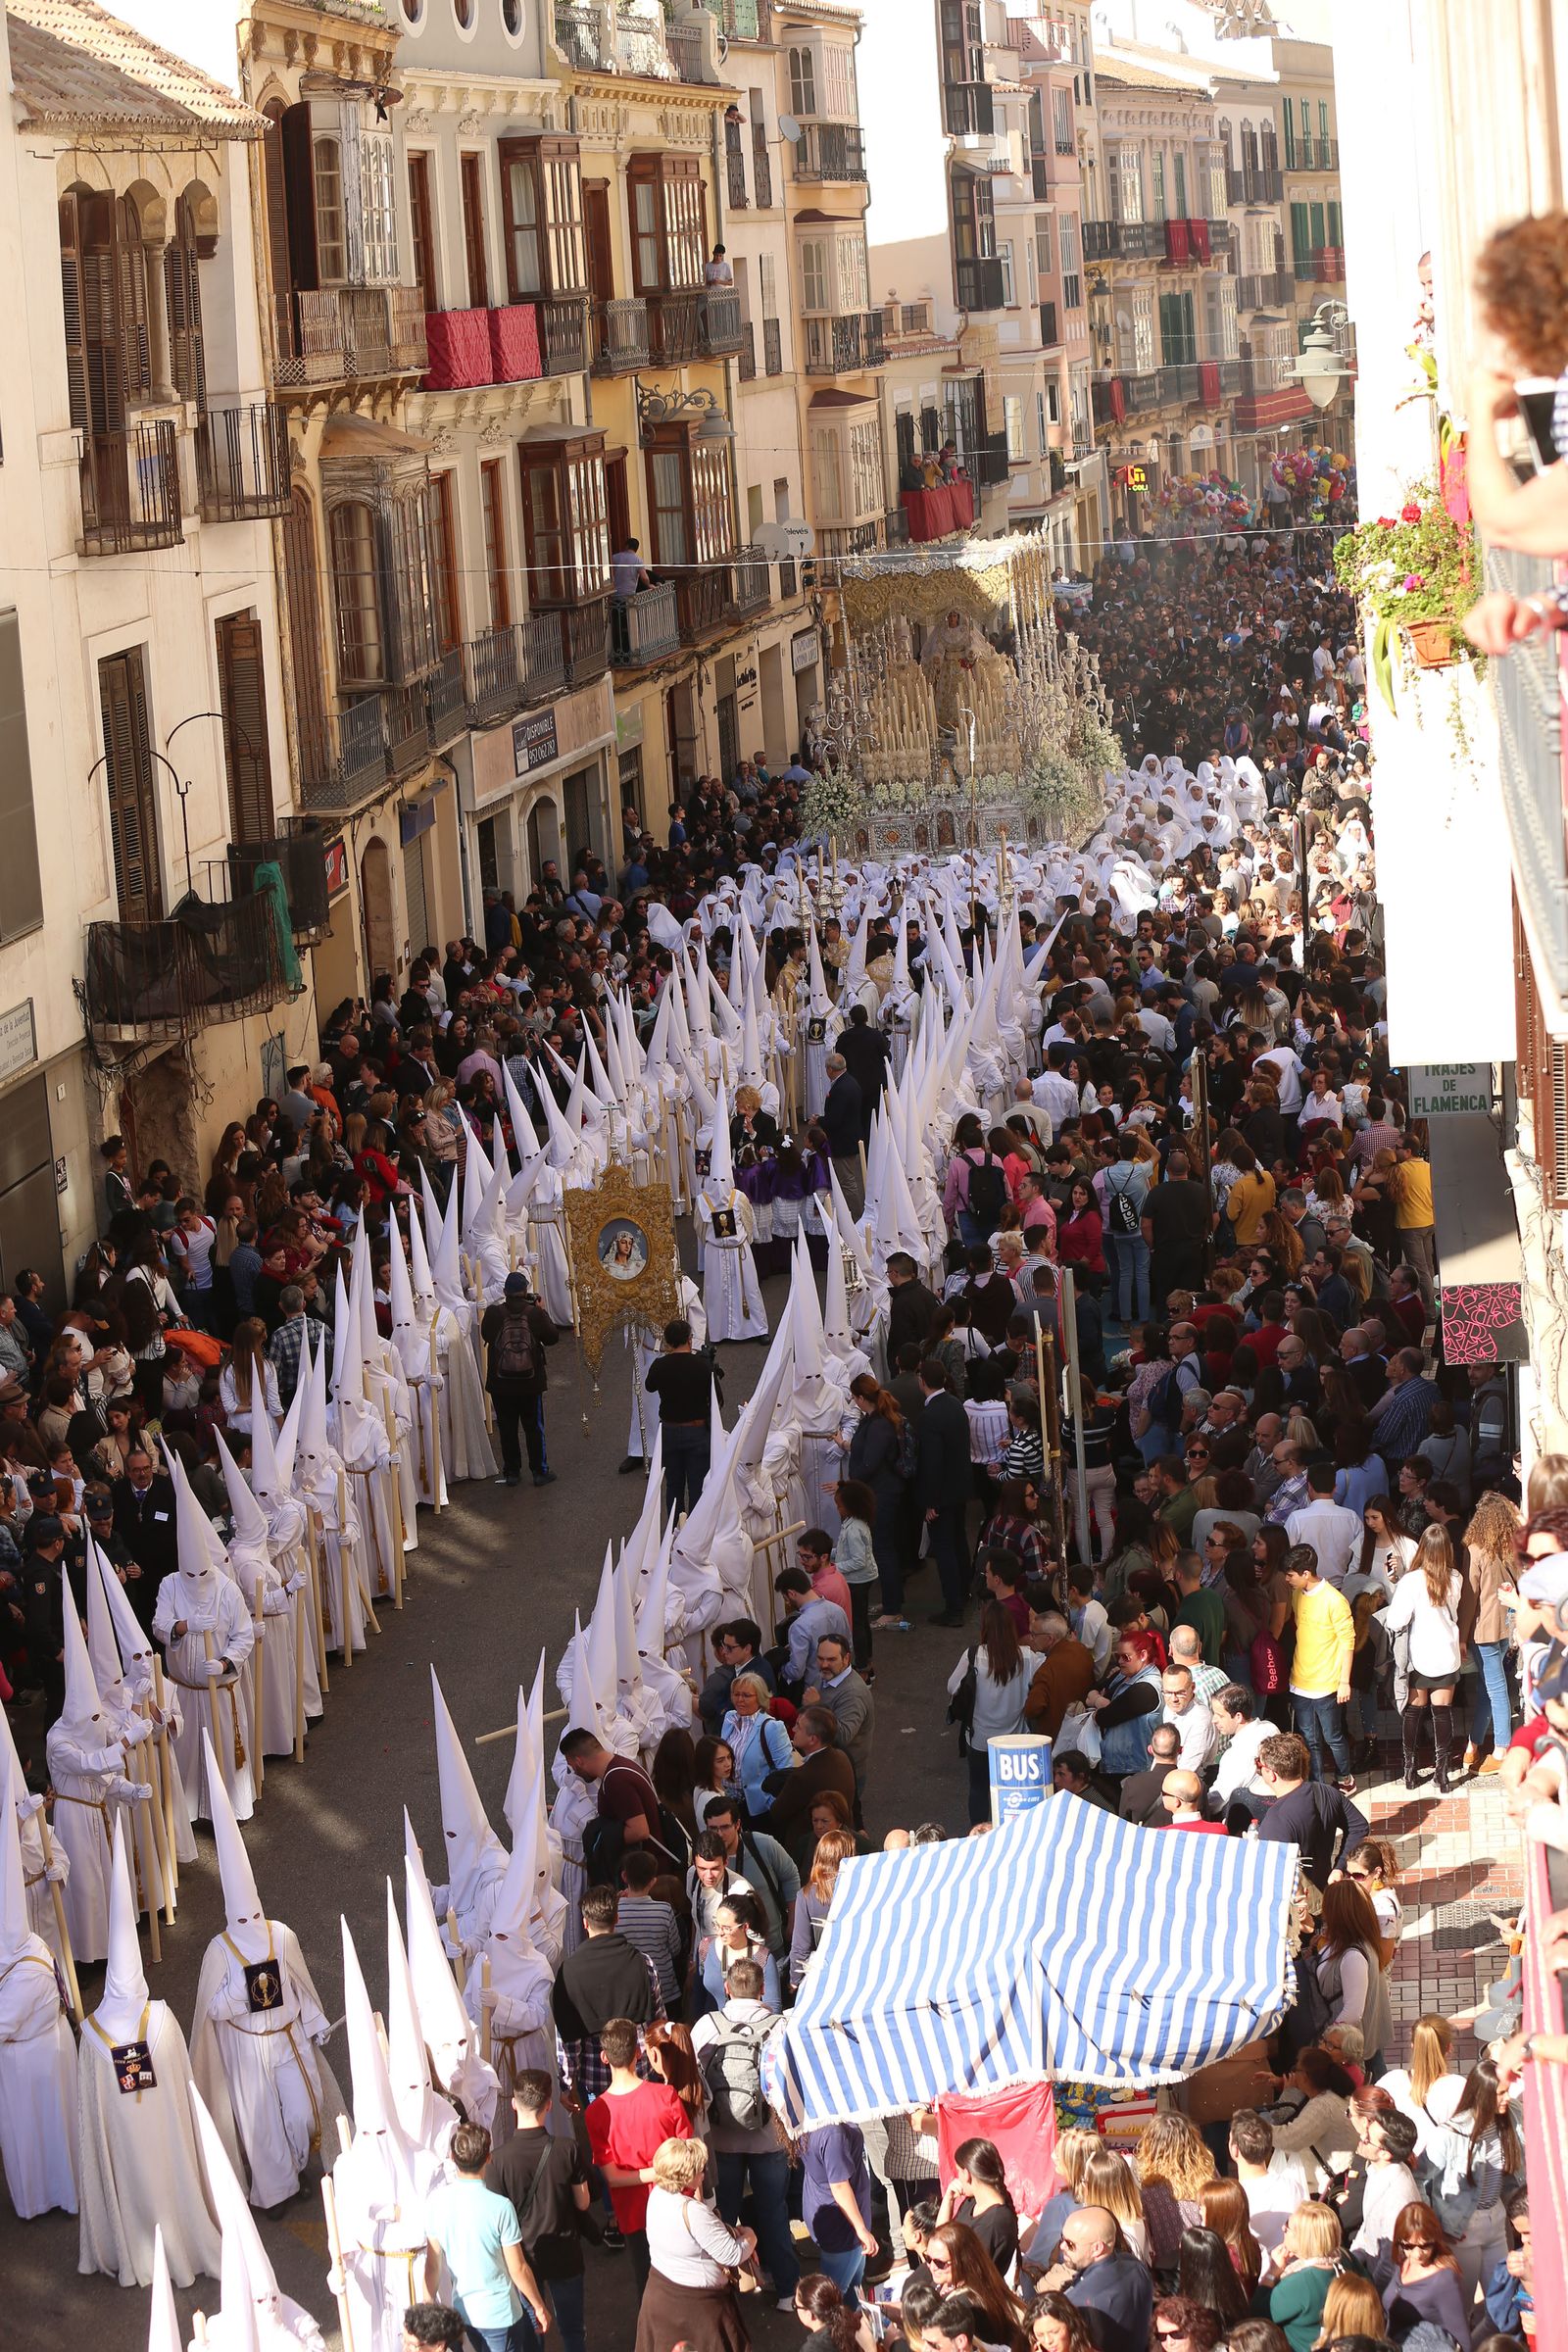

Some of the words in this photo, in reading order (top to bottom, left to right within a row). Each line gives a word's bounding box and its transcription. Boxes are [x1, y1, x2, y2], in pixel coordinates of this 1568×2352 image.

[526, 715, 554, 741] DISPONIBLE
[14, 1010, 30, 1029] Juventud
[1425, 1062, 1476, 1077] TRAJES
[1443, 1079, 1456, 1092] DE
[1414, 1095, 1488, 1114] FLAMENCA
[1000, 1753, 1040, 1782] BUS
